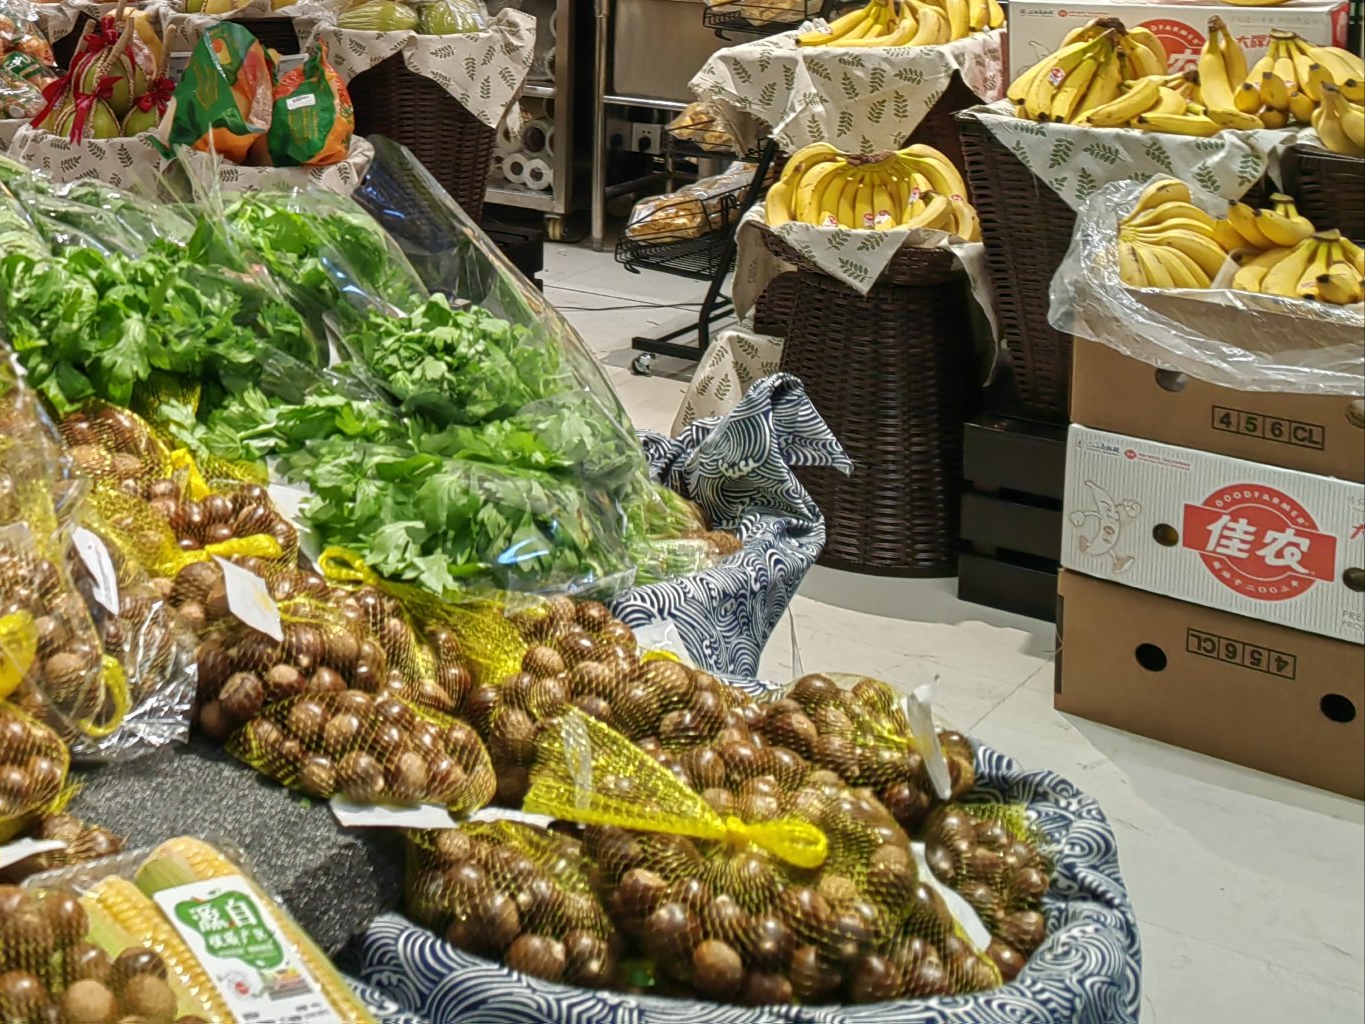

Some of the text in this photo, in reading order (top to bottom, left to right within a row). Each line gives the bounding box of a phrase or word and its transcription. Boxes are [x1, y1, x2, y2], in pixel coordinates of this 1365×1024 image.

[1219, 411, 1321, 445] 4 5 6 CL
[1205, 513, 1311, 574] 佳农
[1190, 632, 1290, 673] 4 5 6 CL
